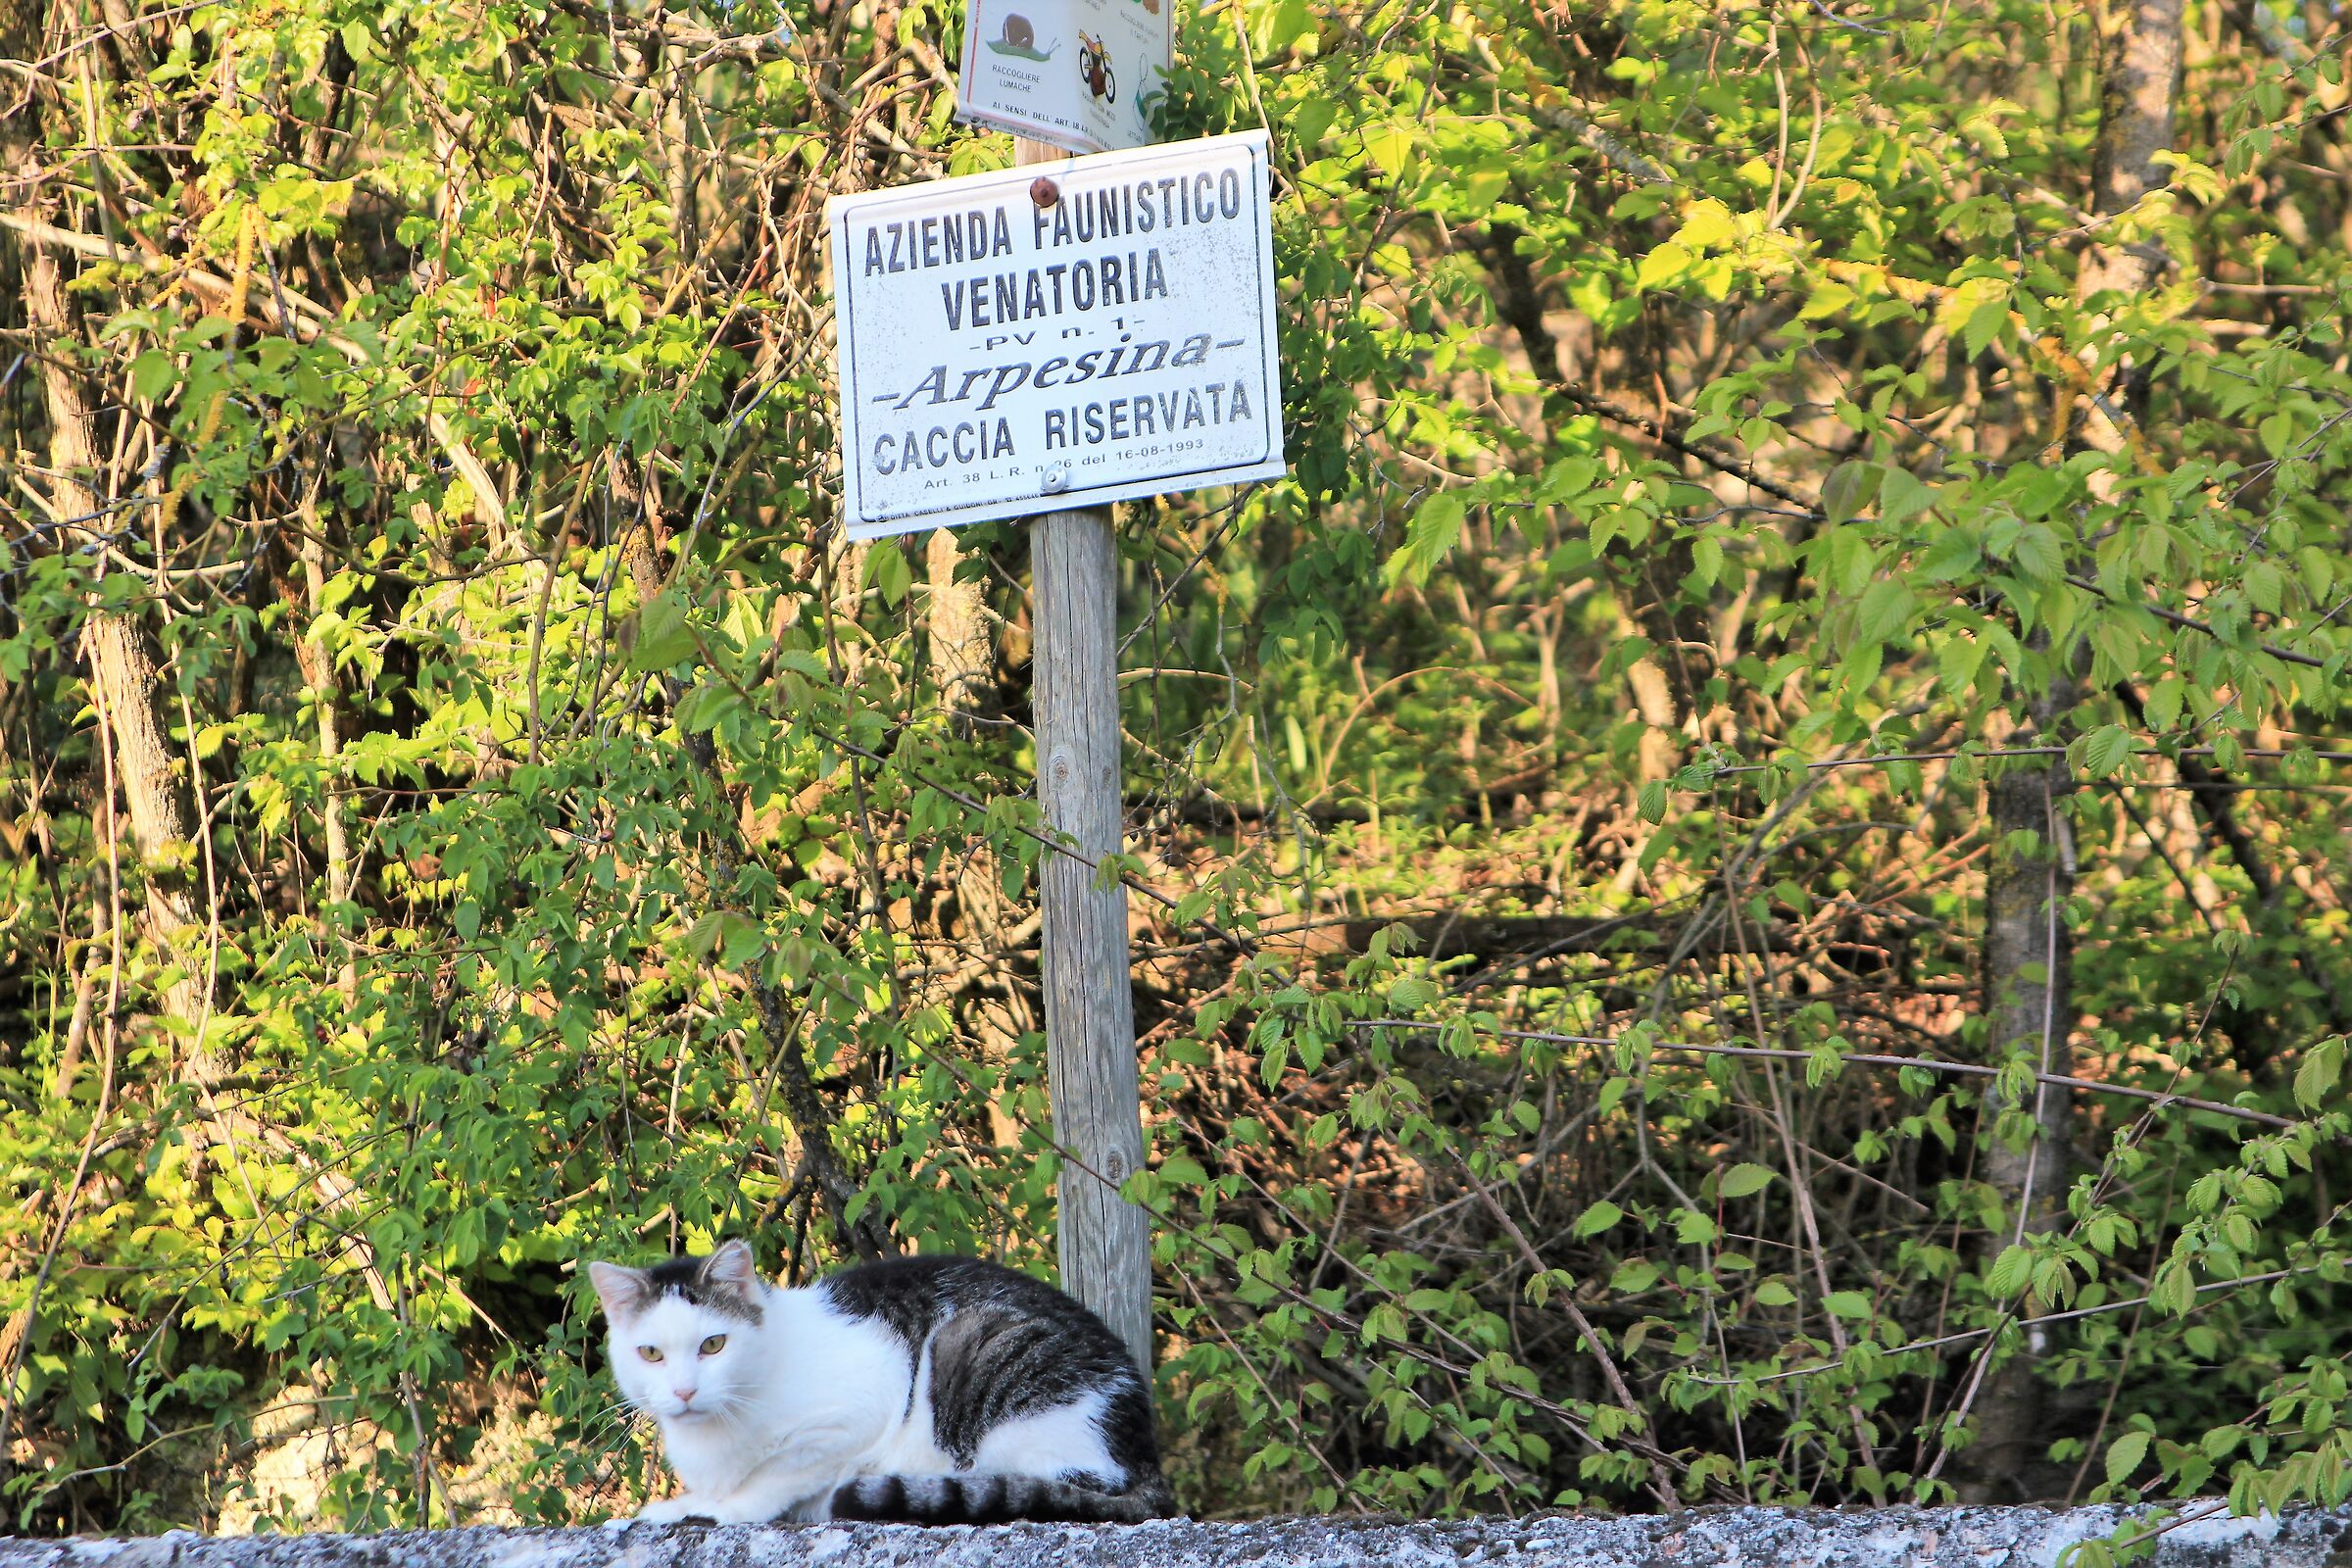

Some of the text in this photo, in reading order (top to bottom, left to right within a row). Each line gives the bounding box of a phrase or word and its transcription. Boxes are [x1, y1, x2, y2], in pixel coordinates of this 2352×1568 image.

[992, 64, 1041, 83] RACCOGLIERE
[999, 78, 1032, 93] LUMACHE
[992, 101, 1001, 110] AI
[1004, 104, 1027, 117] SENSI
[1054, 117, 1070, 128] ART.
[1072, 122, 1080, 130] 18
[864, 167, 1242, 277] AZIENDA FAUNISTICO
[940, 247, 1169, 331] VENATORIA
[873, 378, 1252, 476] CACCIA RISERVATA
[924, 476, 954, 490] Art.
[962, 472, 981, 484] 38
[1081, 453, 1105, 466] del
[1115, 438, 1204, 462] 16-08-1993
